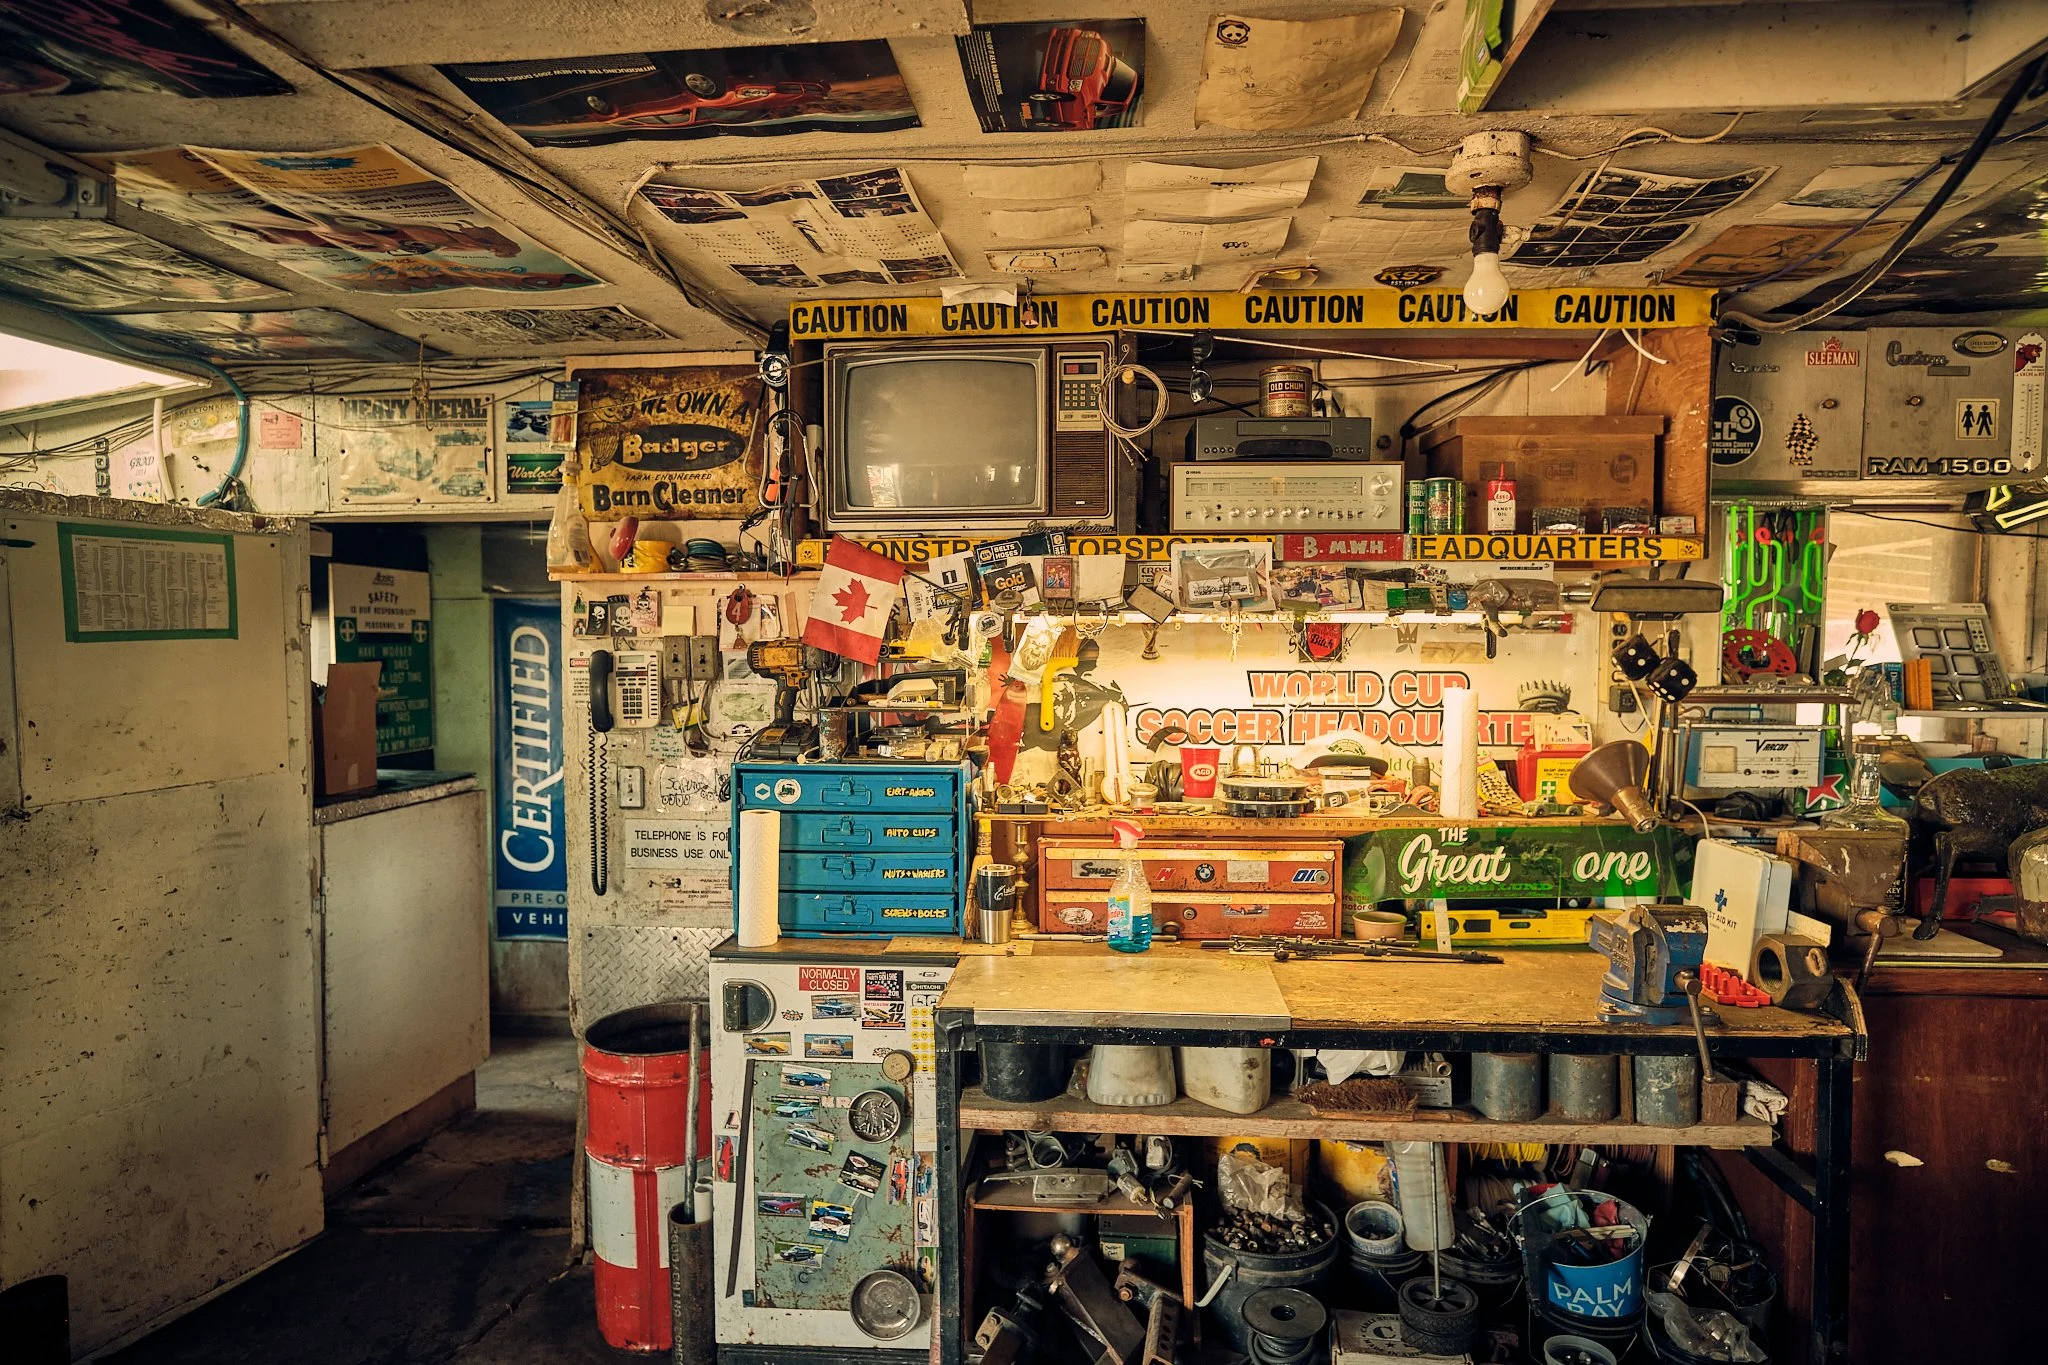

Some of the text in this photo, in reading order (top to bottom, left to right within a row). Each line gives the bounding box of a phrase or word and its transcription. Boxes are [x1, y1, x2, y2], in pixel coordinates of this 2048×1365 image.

[506, 73, 532, 81] DODGE
[602, 65, 657, 75] INTRODUCING
[941, 301, 1059, 331] CAUTION
[1092, 296, 1210, 327] CAUTION
[1245, 295, 1364, 324] CAUTION
[1398, 294, 1518, 324] CAUTN
[1555, 294, 1675, 324] CAUTION
[793, 304, 908, 335] CAUTION
[1808, 352, 1857, 365] SLEEMAN
[1270, 382, 1304, 392] OLD CHUM
[175, 404, 214, 417] SKELETON
[344, 400, 488, 419] HEAVY METAL
[641, 391, 749, 424] WE OWN A
[622, 433, 731, 464] Badger
[1870, 456, 2012, 476] RAM 1500
[625, 472, 712, 482] FARM-ENGINEERED
[592, 482, 748, 512] Barn Cleaner
[993, 542, 1015, 554] BELTS
[994, 550, 1019, 560] HOSES
[1304, 540, 1388, 560] B. M.W.H.
[994, 572, 1026, 589] Gold
[368, 592, 399, 605] SAFETY
[358, 606, 372, 614] OUR
[373, 606, 416, 616] RESPONSIBILITY
[358, 646, 412, 658] HAVE WORKED
[1248, 671, 1469, 706] WORLD CUP
[1136, 708, 1532, 746] SOCCER HEADQUTE
[502, 626, 564, 872] CERTIFIED
[634, 830, 691, 841] TELEPHONE
[698, 832, 706, 841] IS
[886, 829, 936, 838] AUTO CLIPS
[1438, 828, 1470, 843] THE
[630, 848, 729, 858] BUSINESS USE ONL
[1080, 862, 1123, 878] Snap-o
[1400, 834, 1652, 895] Great one
[1292, 869, 1319, 883] OI
[511, 892, 566, 905] PRE-O
[1108, 910, 1124, 919] ndex
[1716, 913, 1738, 930] AID KIT
[801, 968, 857, 980] NORMALLY
[809, 980, 850, 991] CLOSED
[888, 1002, 904, 1012] 20
[888, 1012, 904, 1023] 17
[1552, 1276, 1632, 1308] PALM
[1372, 1326, 1396, 1339] C
